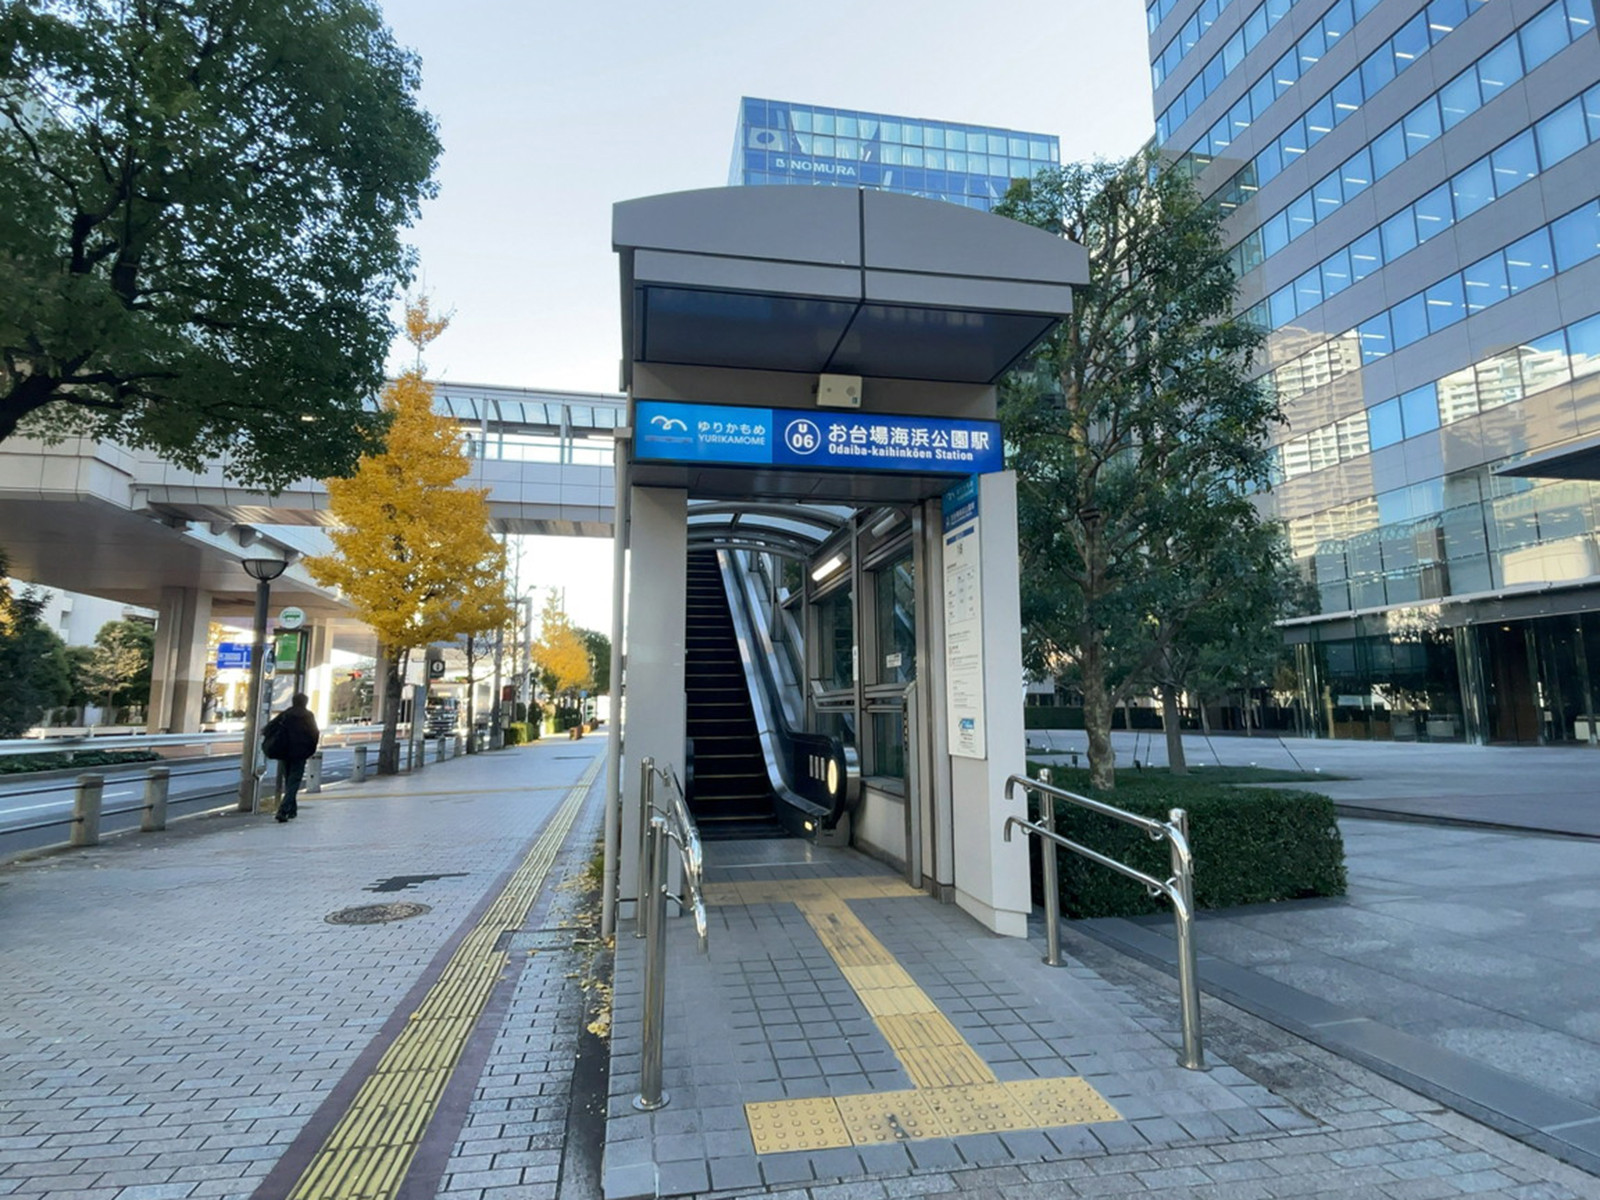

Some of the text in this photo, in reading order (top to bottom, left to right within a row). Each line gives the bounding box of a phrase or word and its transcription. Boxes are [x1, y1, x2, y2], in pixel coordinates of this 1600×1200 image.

[790, 160, 856, 176] NOMURA
[698, 421, 766, 435] ゆりかもめ
[798, 423, 808, 433] U
[698, 434, 766, 445] YURIKAMOME
[792, 433, 814, 448] 06
[828, 423, 990, 450] お台場海浜公園駅
[935, 448, 974, 461] Station
